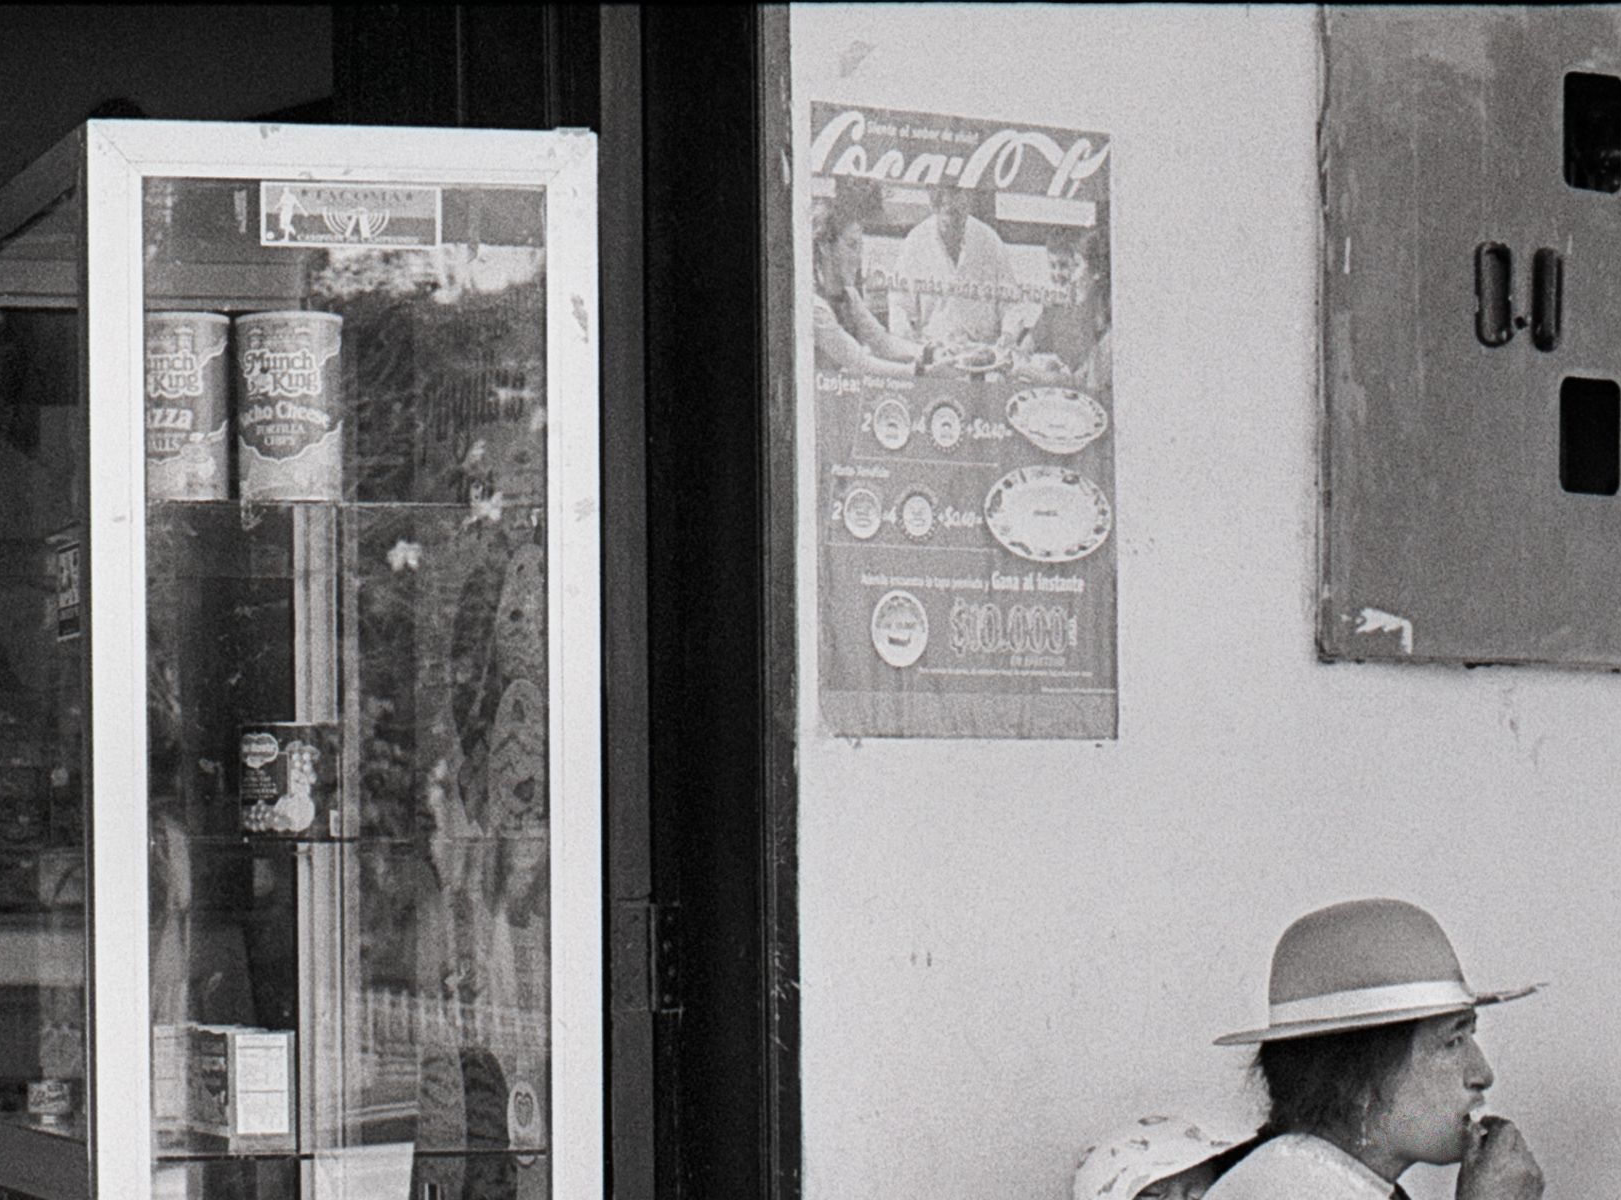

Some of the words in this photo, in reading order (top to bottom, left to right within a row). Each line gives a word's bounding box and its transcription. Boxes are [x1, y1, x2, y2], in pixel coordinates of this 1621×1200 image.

[244, 349, 314, 375] Munch
[270, 371, 319, 394] King
[1023, 572, 1034, 591] al
